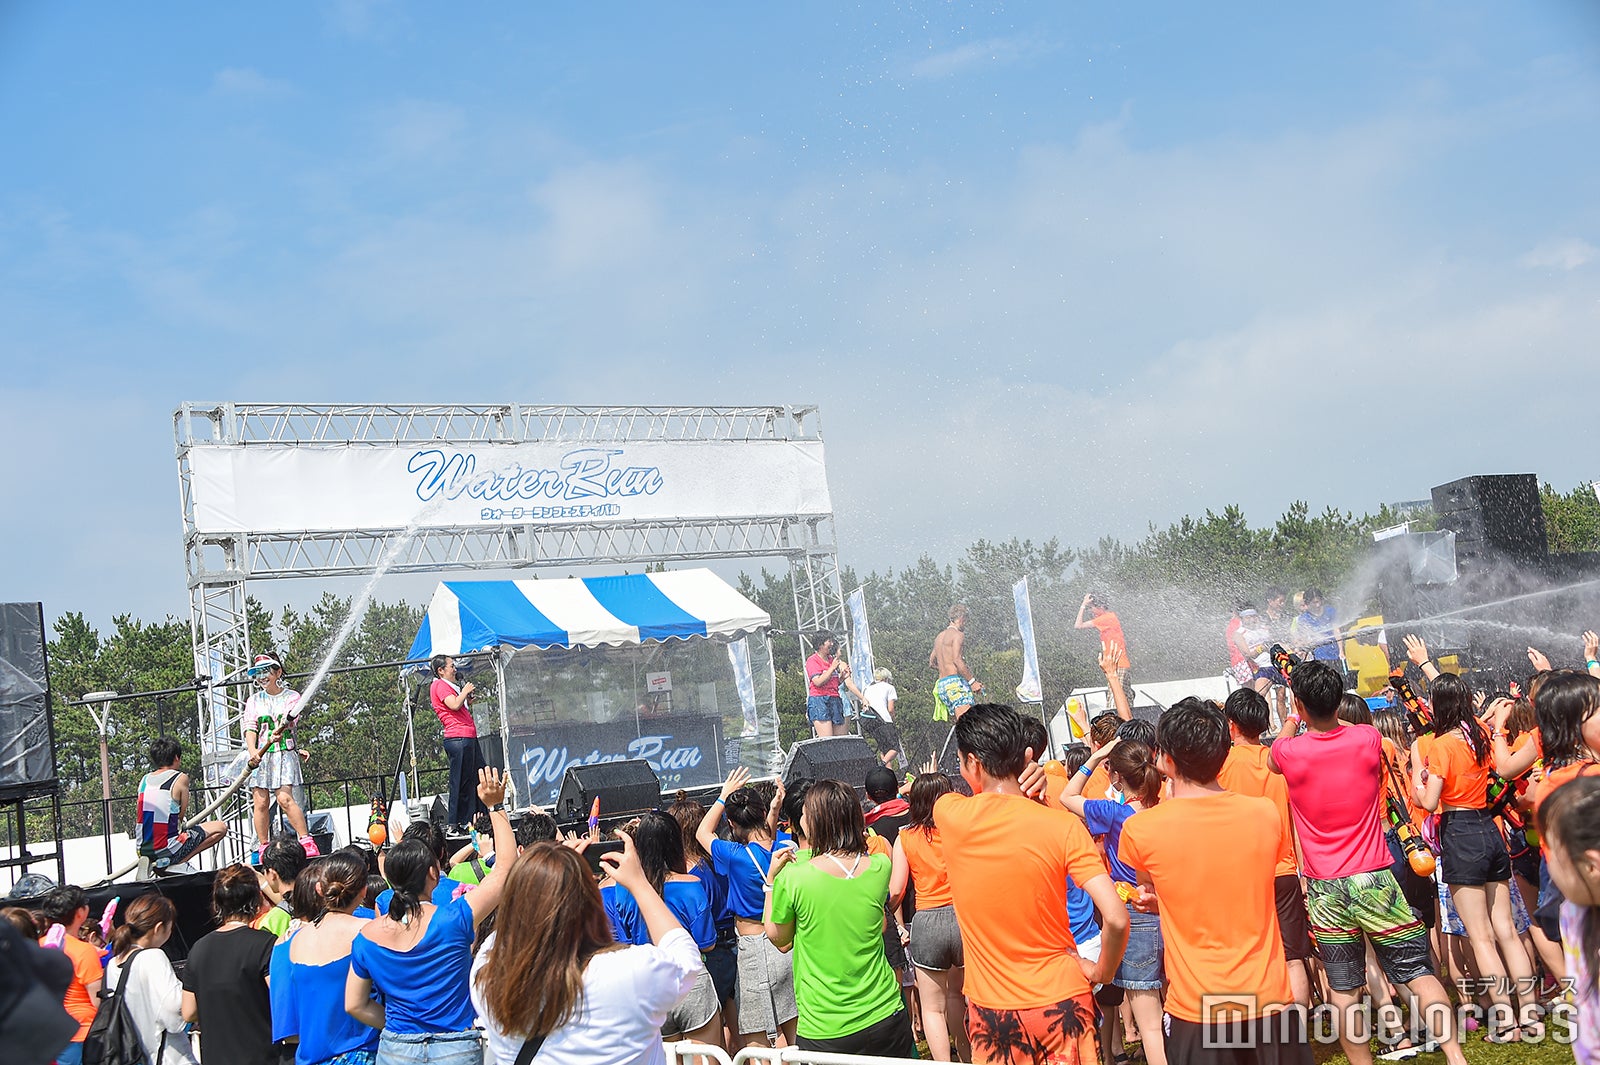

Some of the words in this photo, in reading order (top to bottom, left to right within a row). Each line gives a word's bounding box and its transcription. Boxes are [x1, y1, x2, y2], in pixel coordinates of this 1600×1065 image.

[407, 450, 564, 501] Water
[560, 448, 663, 500] Run
[480, 503, 620, 520] ウォーターランフェスティバル
[627, 736, 702, 771] Run
